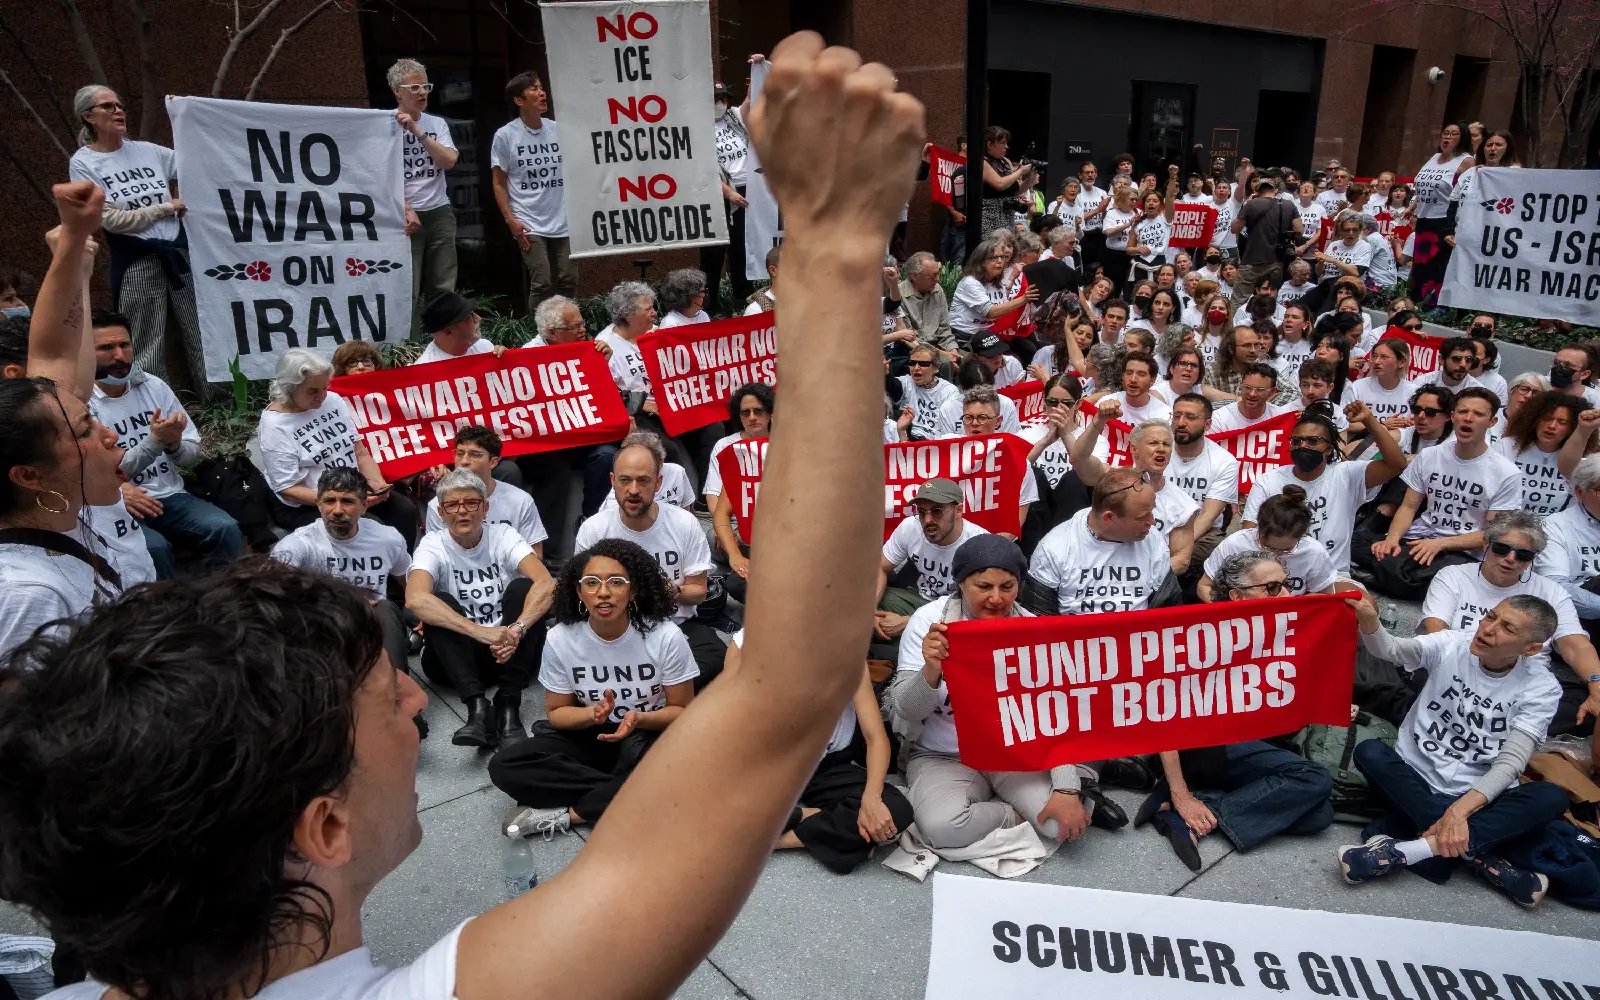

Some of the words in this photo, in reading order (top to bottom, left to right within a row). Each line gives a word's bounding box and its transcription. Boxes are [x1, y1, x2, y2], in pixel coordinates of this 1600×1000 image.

[596, 11, 659, 43] NO
[613, 45, 652, 83] ICE
[607, 94, 668, 125] NO
[246, 128, 341, 186] NO
[517, 142, 559, 157] FUND
[591, 126, 693, 165] FASCISM
[517, 154, 562, 168] PEOPLE
[527, 167, 558, 179] NOT
[102, 167, 156, 191] FUND
[111, 180, 167, 202] PEOPLE
[521, 178, 564, 190] BOMBS
[617, 173, 678, 203] NO
[127, 193, 164, 211] NOT
[1521, 193, 1588, 224] STOP
[217, 189, 379, 243] WAR
[591, 203, 716, 247] GENOCIDE
[1058, 212, 1074, 221] FUN
[1174, 211, 1208, 225] EOPLE
[1481, 225, 1523, 259] US
[282, 255, 335, 287] ON
[1474, 263, 1531, 293] WAR
[1540, 270, 1600, 301] MAC
[230, 293, 387, 355] IRAN
[656, 344, 691, 380] NO
[691, 333, 747, 371] WAR
[750, 326, 778, 359] NO
[1283, 354, 1310, 362] UND
[1413, 345, 1434, 371] NO
[343, 392, 392, 430] NO
[393, 376, 483, 421] WAR
[484, 366, 537, 407] NO
[537, 358, 590, 397] ICE
[662, 374, 714, 413] FREE
[715, 357, 778, 400] PALES
[114, 410, 155, 436] UND
[293, 418, 320, 440] JEWS
[320, 408, 340, 425] SAY
[301, 421, 348, 454] FUND
[1236, 428, 1284, 461] ICE
[324, 449, 355, 471] NOT
[888, 445, 939, 480] NO
[949, 438, 1004, 479] ICE
[1429, 471, 1485, 496] FUND
[1522, 478, 1565, 492] EOPLE
[1427, 486, 1481, 508] PEOPLE
[1522, 489, 1556, 504] OT
[1524, 503, 1558, 514] MBS
[1431, 511, 1474, 532] OMBS
[1433, 501, 1467, 518] NOT
[326, 555, 384, 572] FUND
[912, 553, 949, 578] FUN
[1079, 566, 1141, 584] FUND
[1075, 586, 1144, 599] PEOPLE
[462, 599, 502, 617] NO
[1080, 600, 1134, 613] NOT
[1461, 602, 1493, 616] JEW
[993, 635, 1118, 693] FUND
[1129, 610, 1298, 678] PEOPLE
[572, 663, 655, 684] FUND
[613, 702, 650, 720] OT
[997, 686, 1098, 748] NOT
[1112, 660, 1297, 728] BOMBS
[1441, 686, 1507, 733] FUND
[1427, 721, 1491, 761] NOT
[992, 919, 1246, 988] SCHUMER
[1254, 950, 1291, 992] &
